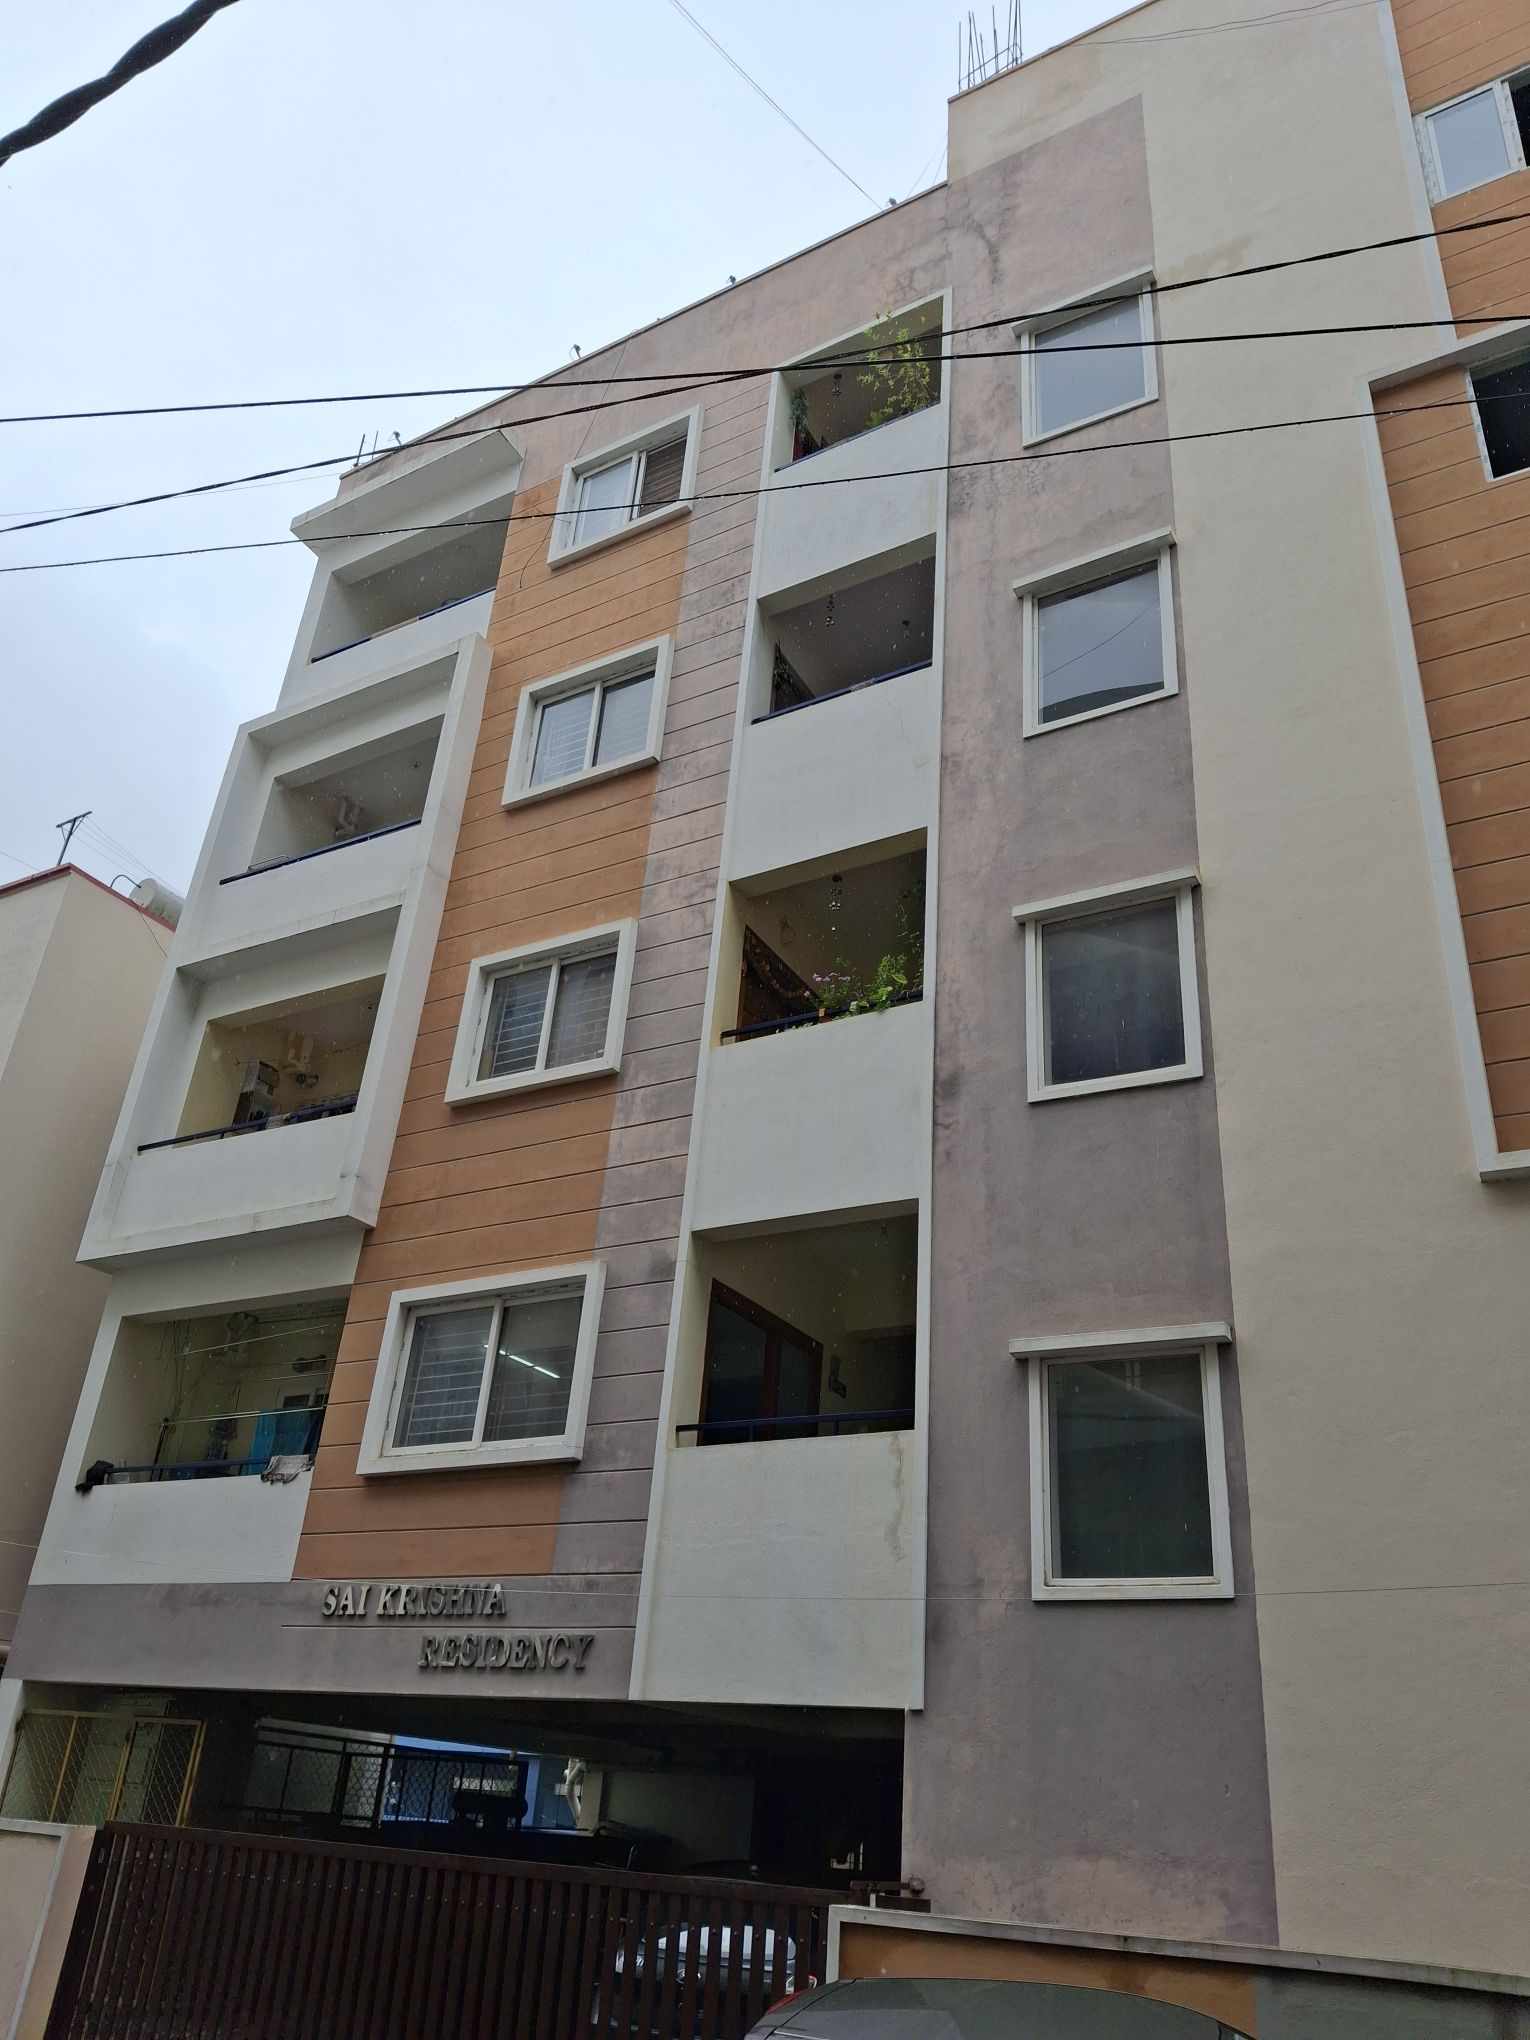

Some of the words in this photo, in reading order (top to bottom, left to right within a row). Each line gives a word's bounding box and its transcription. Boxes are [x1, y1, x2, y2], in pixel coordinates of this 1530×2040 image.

[322, 1584, 370, 1617] SAI
[375, 1583, 507, 1616] KRISHNA
[417, 1633, 595, 1669] RESIDENCY
